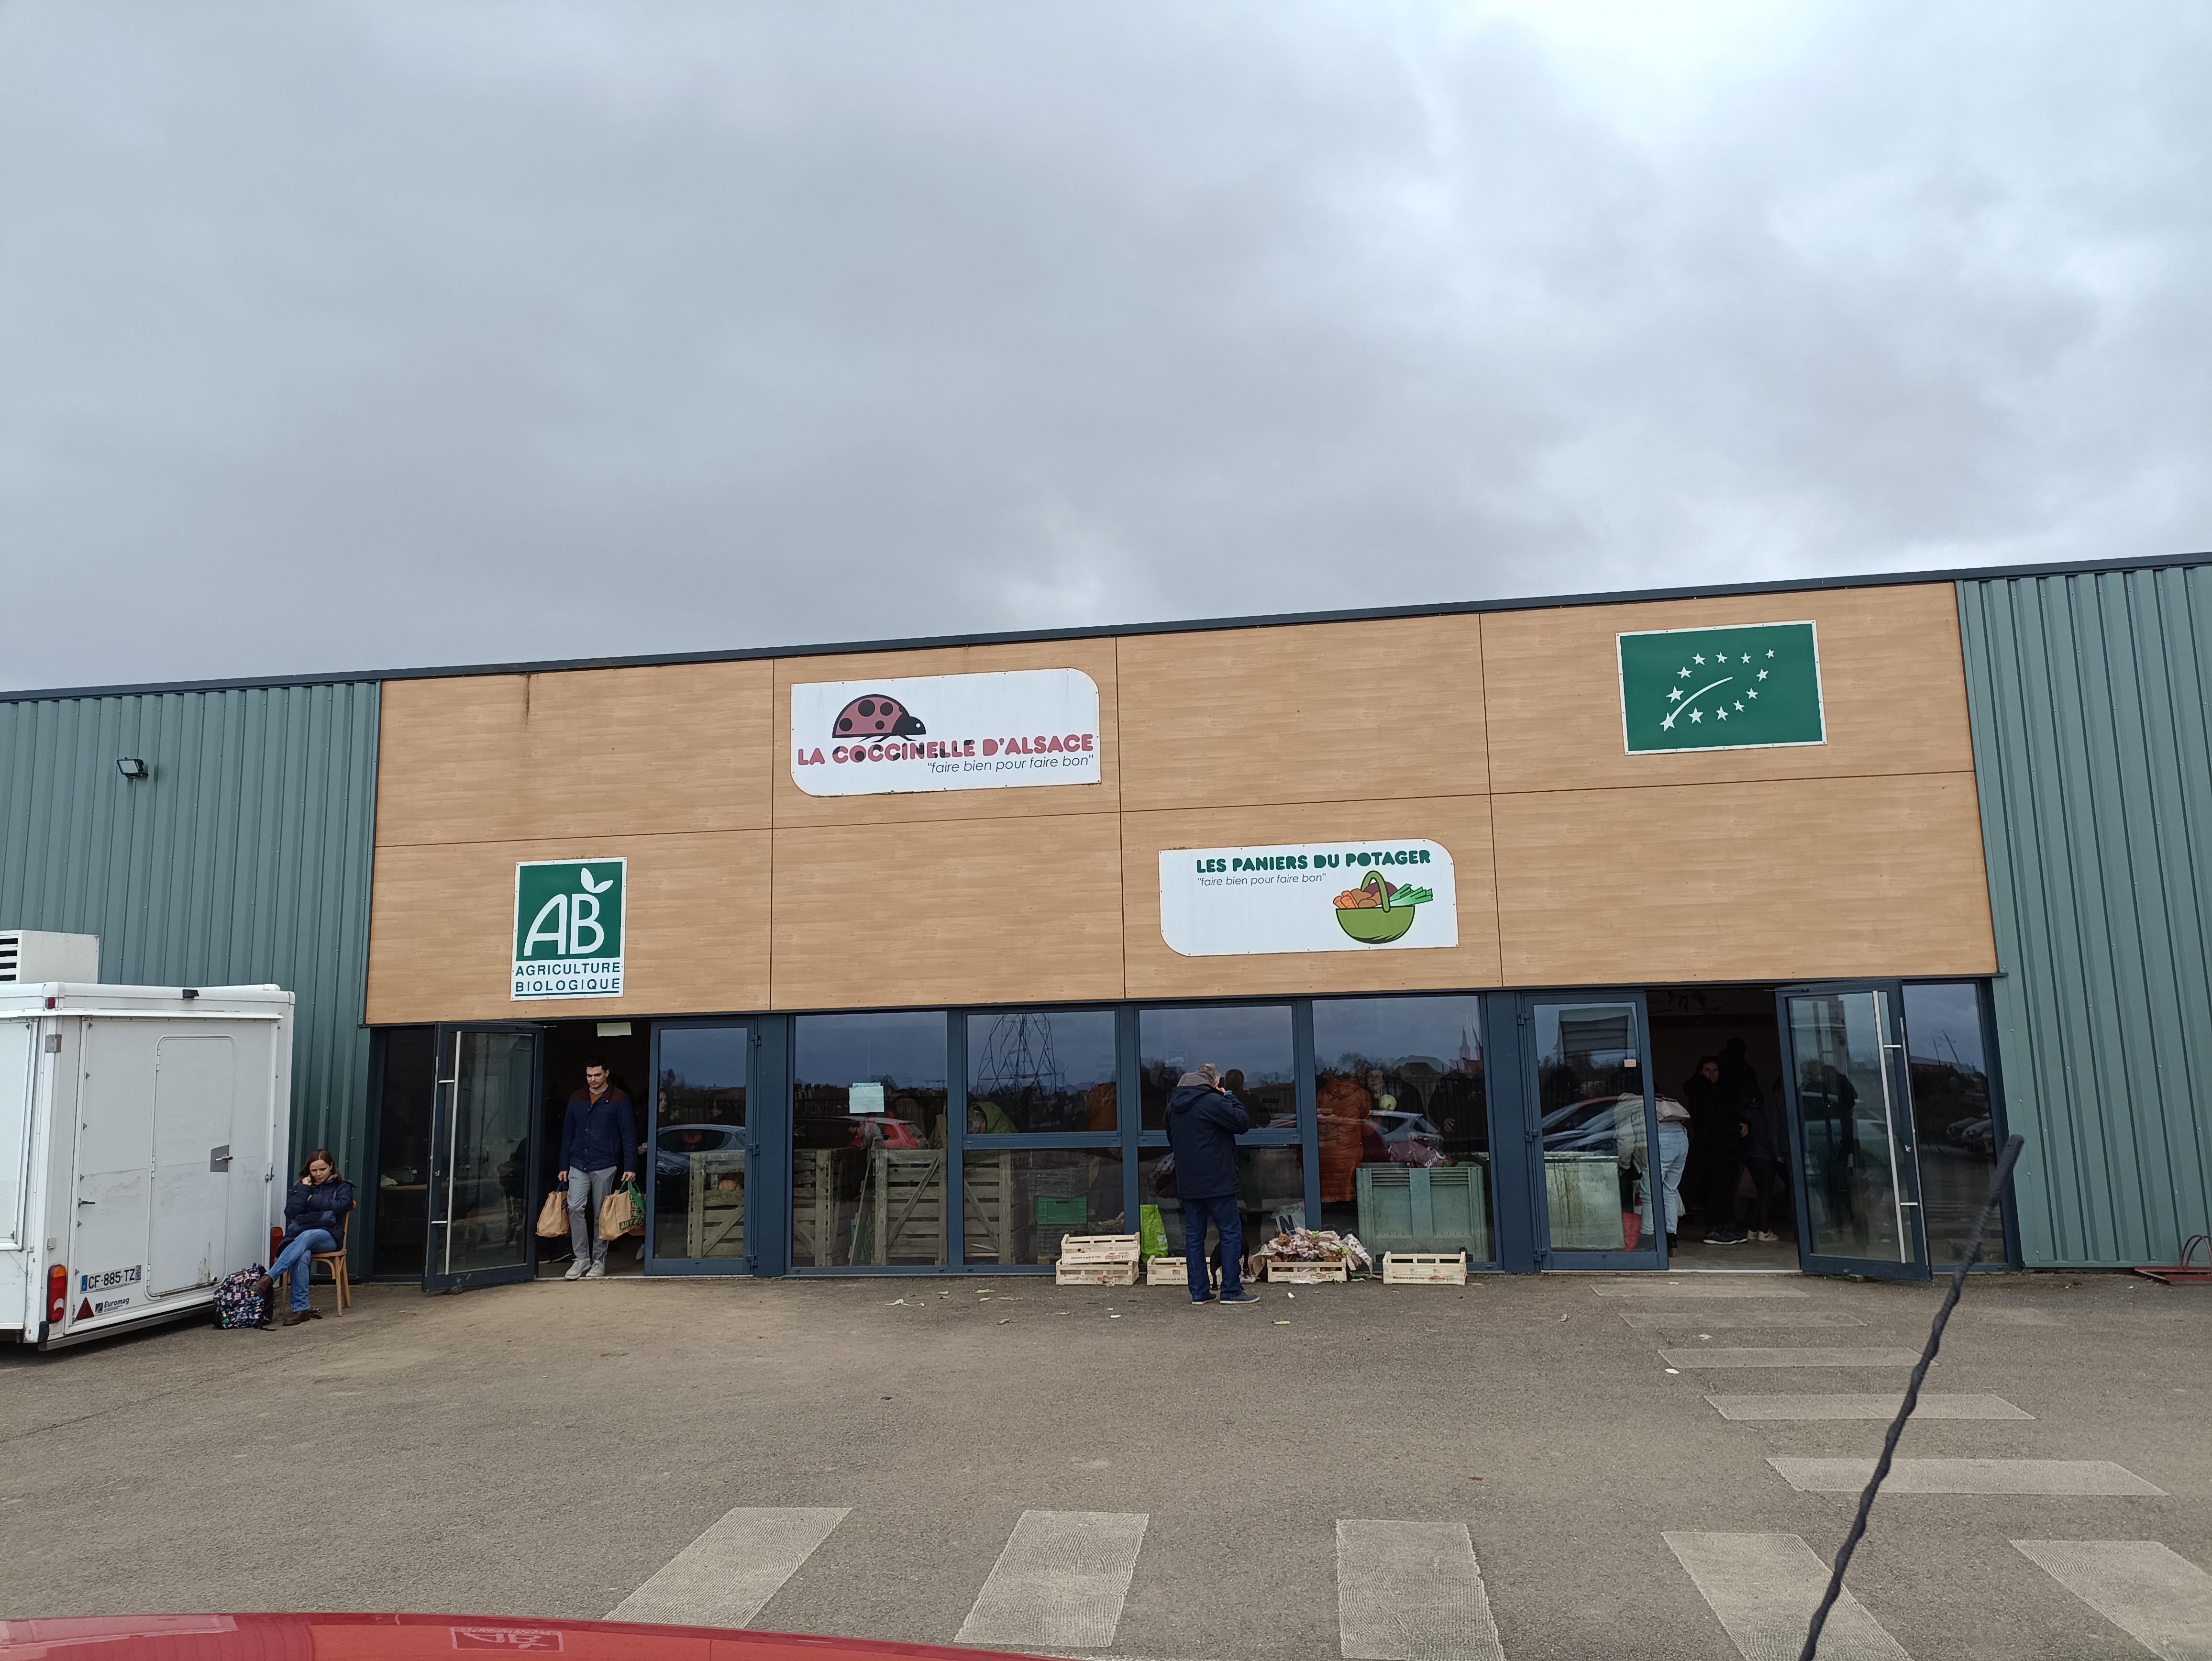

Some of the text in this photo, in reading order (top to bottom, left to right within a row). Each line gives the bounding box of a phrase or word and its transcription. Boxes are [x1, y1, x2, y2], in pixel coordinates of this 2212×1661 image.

[797, 734, 1094, 765] LA COCCINELLE D'ALSACE
[927, 754, 1094, 774] "faire bien pour faire bon"
[1196, 850, 1431, 873] LES PANIERS DU POTAGER
[1197, 872, 1327, 887] "faire bien pour faire bon"
[524, 893, 604, 956] AB
[515, 962, 620, 976] AGRICULTURE
[515, 978, 620, 992] BIOLOGIQUE
[88, 1268, 135, 1289] CF-885-TZ
[104, 1297, 130, 1308] Euromag
